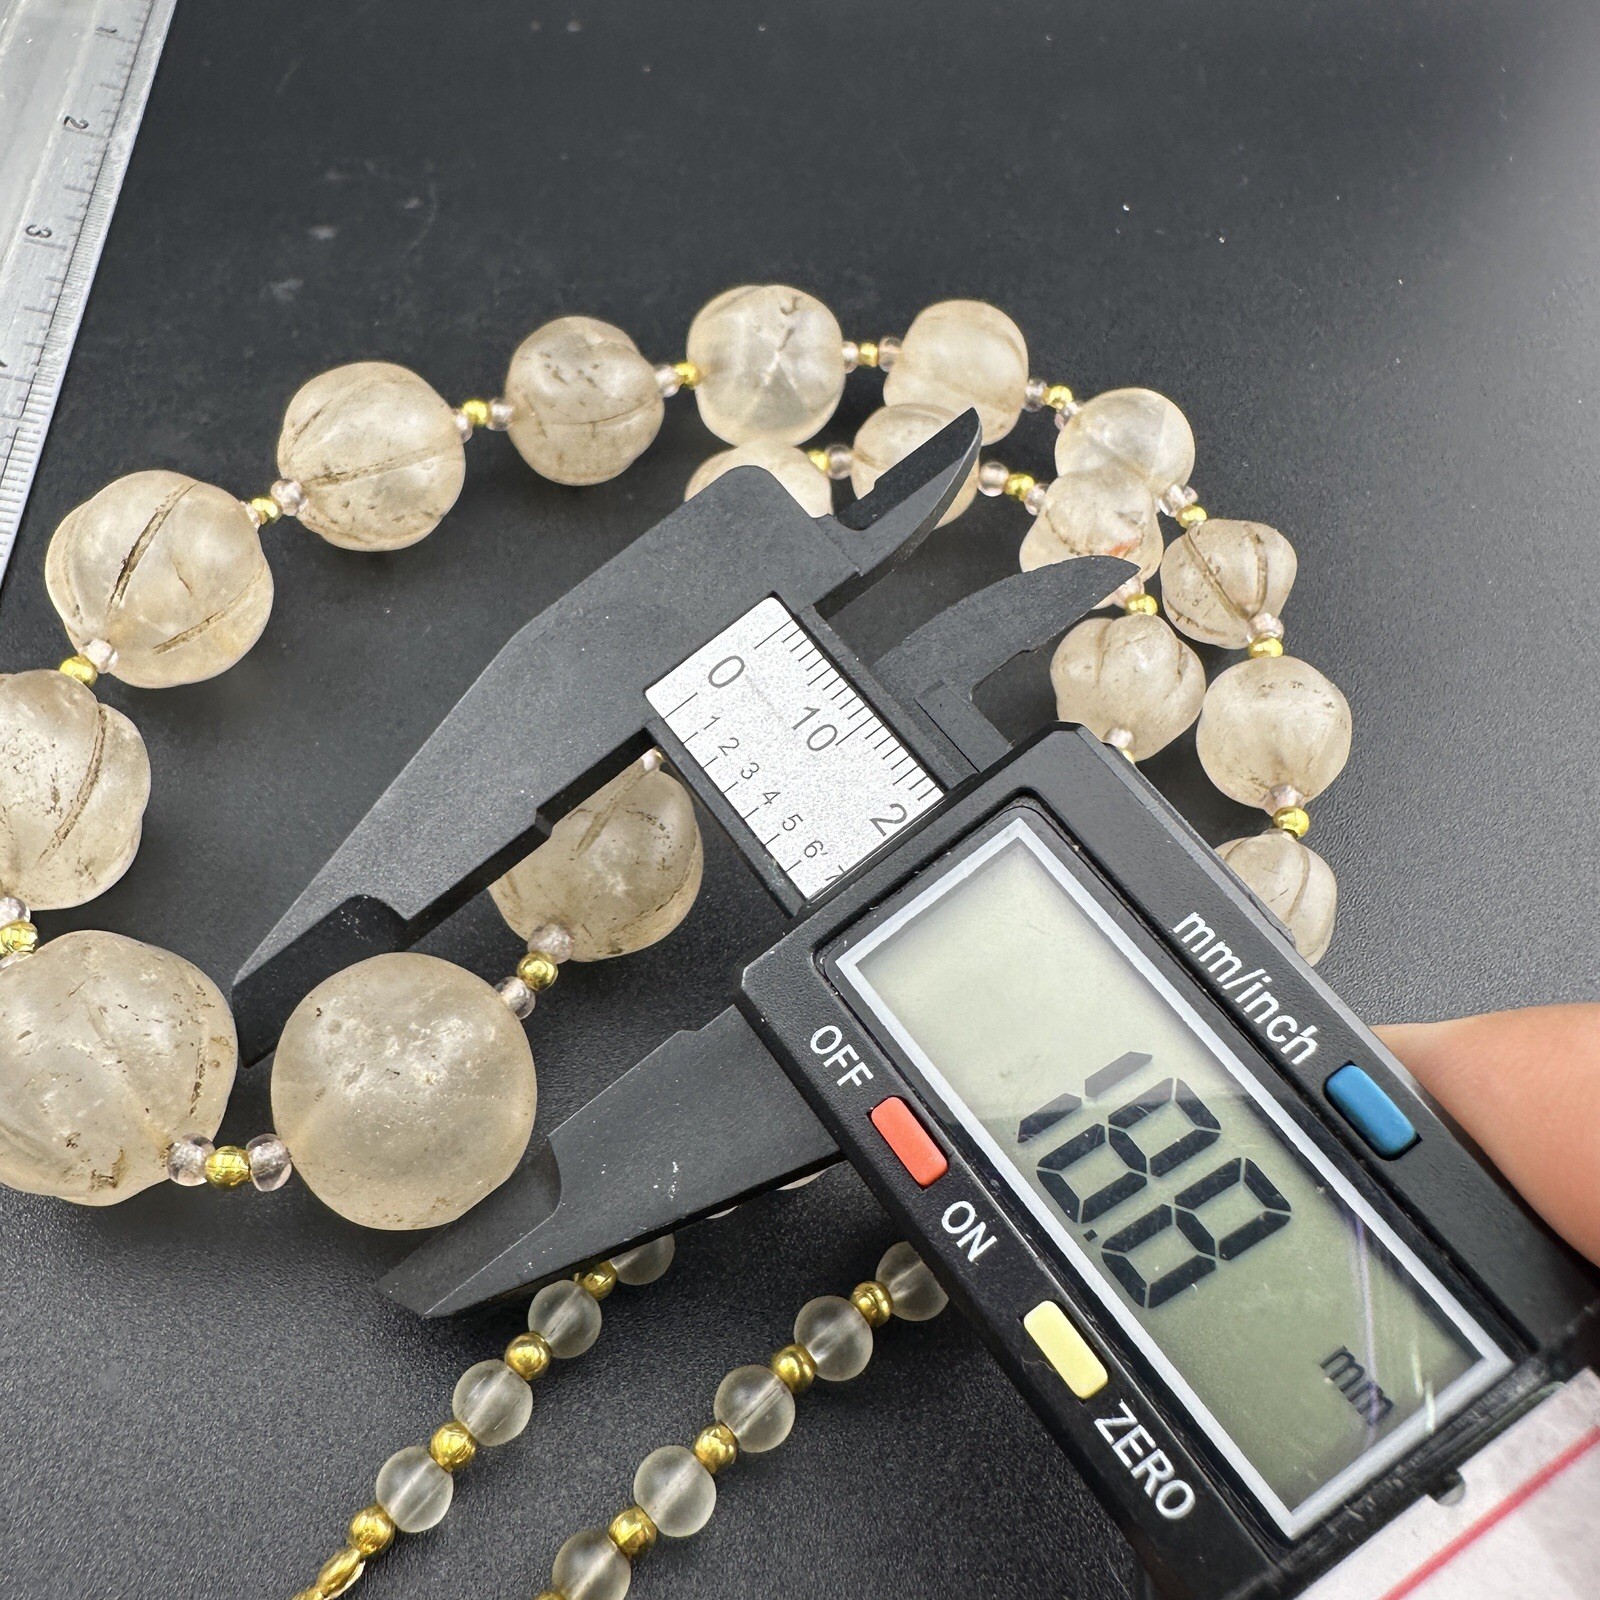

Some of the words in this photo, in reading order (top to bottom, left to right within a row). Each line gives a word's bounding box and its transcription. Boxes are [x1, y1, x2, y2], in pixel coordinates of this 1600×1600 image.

[63, 115, 90, 130] 2
[25, 224, 52, 239] 3
[708, 655, 745, 689] 0
[791, 706, 838, 751] 10
[703, 715, 721, 731] 1
[718, 737, 740, 757] 2
[740, 762, 760, 780] 3
[762, 790, 781, 806] 4
[782, 813, 804, 832] 5
[803, 840, 824, 859] 6
[1172, 911, 1321, 1065] mm/inch
[808, 1024, 875, 1088] OFF
[940, 1200, 998, 1261] ON
[1017, 1050, 1293, 1310] 18.8
[1318, 1345, 1395, 1426] mm
[1093, 1401, 1197, 1520] ZERO
